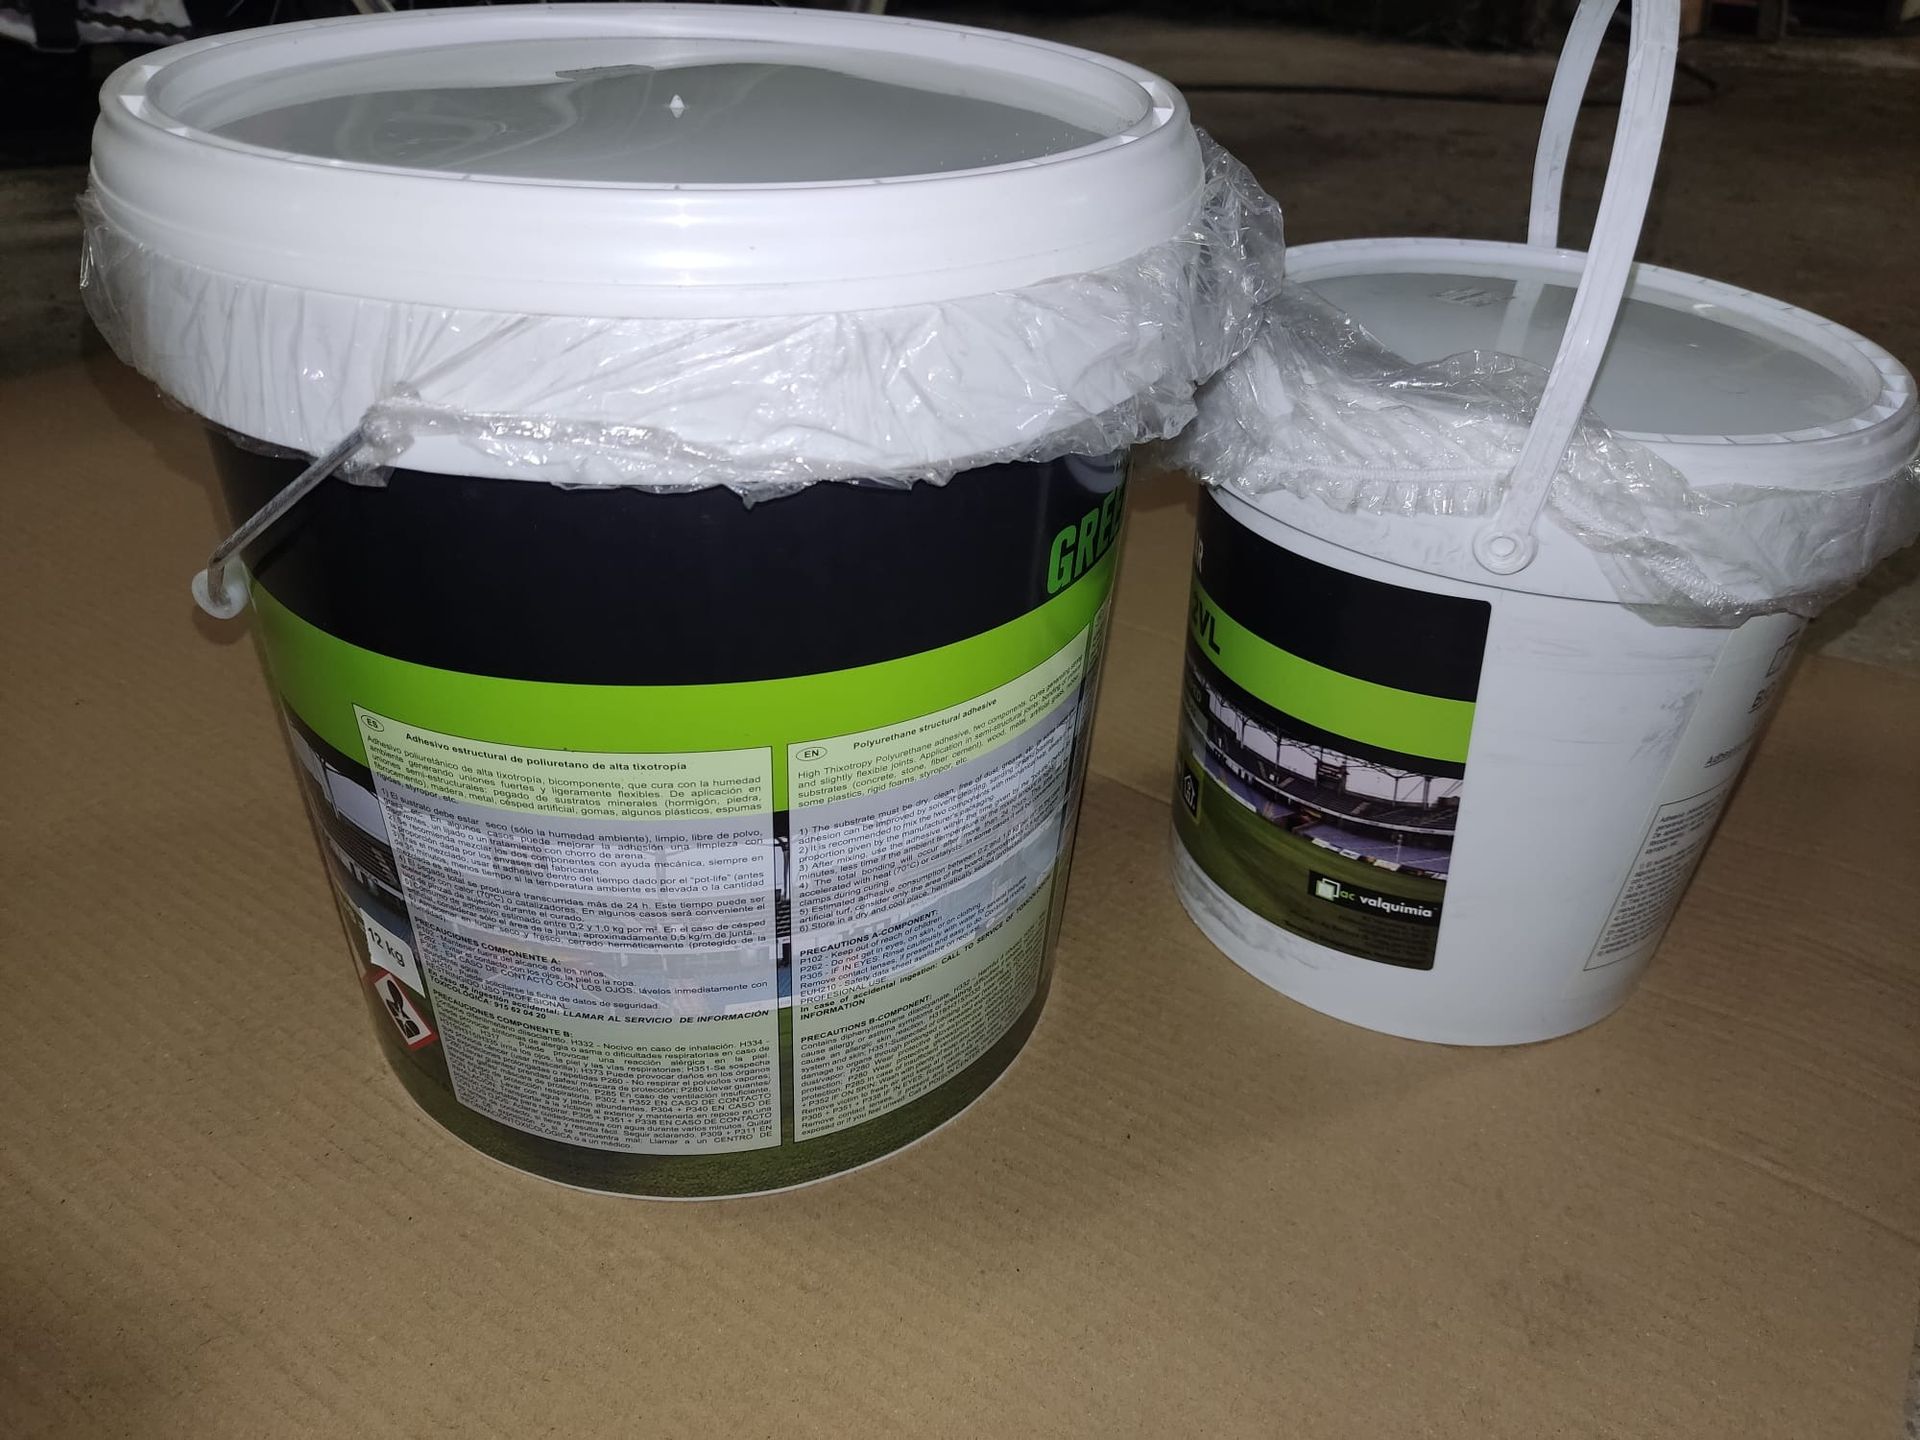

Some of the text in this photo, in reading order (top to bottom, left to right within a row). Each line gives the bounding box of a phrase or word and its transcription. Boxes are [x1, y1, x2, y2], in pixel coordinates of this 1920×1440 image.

[853, 728, 917, 750] Polyurethane
[919, 712, 961, 733] structural
[451, 746, 508, 761] estructural
[526, 758, 589, 769] poliuretano
[609, 762, 630, 771] alta
[632, 762, 687, 771] tixotropía
[798, 769, 821, 780] High
[824, 760, 872, 774] Thixotropy
[875, 742, 932, 764] Polyurethane
[798, 779, 816, 789] and
[820, 773, 852, 785] slightly
[856, 765, 888, 778] flexible
[919, 740, 963, 761] Application
[458, 774, 496, 786] uniones
[500, 780, 535, 792] fuertes
[551, 786, 612, 798] ligeramente
[690, 787, 743, 798] aplicación
[476, 768, 494, 777] alta
[627, 782, 647, 791] que
[677, 781, 697, 789] con
[712, 776, 761, 787] humedad
[798, 784, 848, 799] substrates
[930, 755, 948, 766] fiber
[493, 789, 530, 800] pegado
[554, 797, 601, 806] sustratos
[607, 799, 658, 808] minerales
[499, 798, 535, 809] césped
[621, 808, 662, 818] algunos
[715, 803, 762, 814] espumas
[798, 798, 825, 808] some
[867, 782, 887, 794] rigid
[812, 825, 830, 833] The
[833, 814, 876, 829] substrate
[878, 807, 900, 818] must
[958, 780, 973, 792] free
[457, 815, 479, 825] estar
[485, 821, 508, 832] seco
[510, 824, 534, 835] (sólo
[548, 830, 595, 841] humedad
[691, 833, 714, 842] libre
[798, 880, 852, 898] accelerated
[853, 876, 871, 886] with
[872, 869, 892, 881] heat
[893, 859, 920, 876] (70°C)
[799, 879, 889, 907] clamps during curing
[1340, 889, 1433, 918] ac valquimia
[367, 927, 406, 968] 12 kg
[480, 942, 548, 963] COMPONENTE
[799, 934, 870, 957] PRECAUTIONS
[813, 1000, 835, 1010] case
[853, 979, 896, 1000] accidental
[941, 950, 961, 964] CALL
[471, 986, 510, 1006] ingestión
[563, 1010, 605, 1021] LLAMAR
[624, 1016, 673, 1024] SERVICIO
[696, 1009, 769, 1023] INFORMACIÓN
[800, 998, 866, 1021] INFORMATION
[496, 1015, 561, 1036] COMPONENTE
[800, 1020, 867, 1044] PRECAUTIONS
